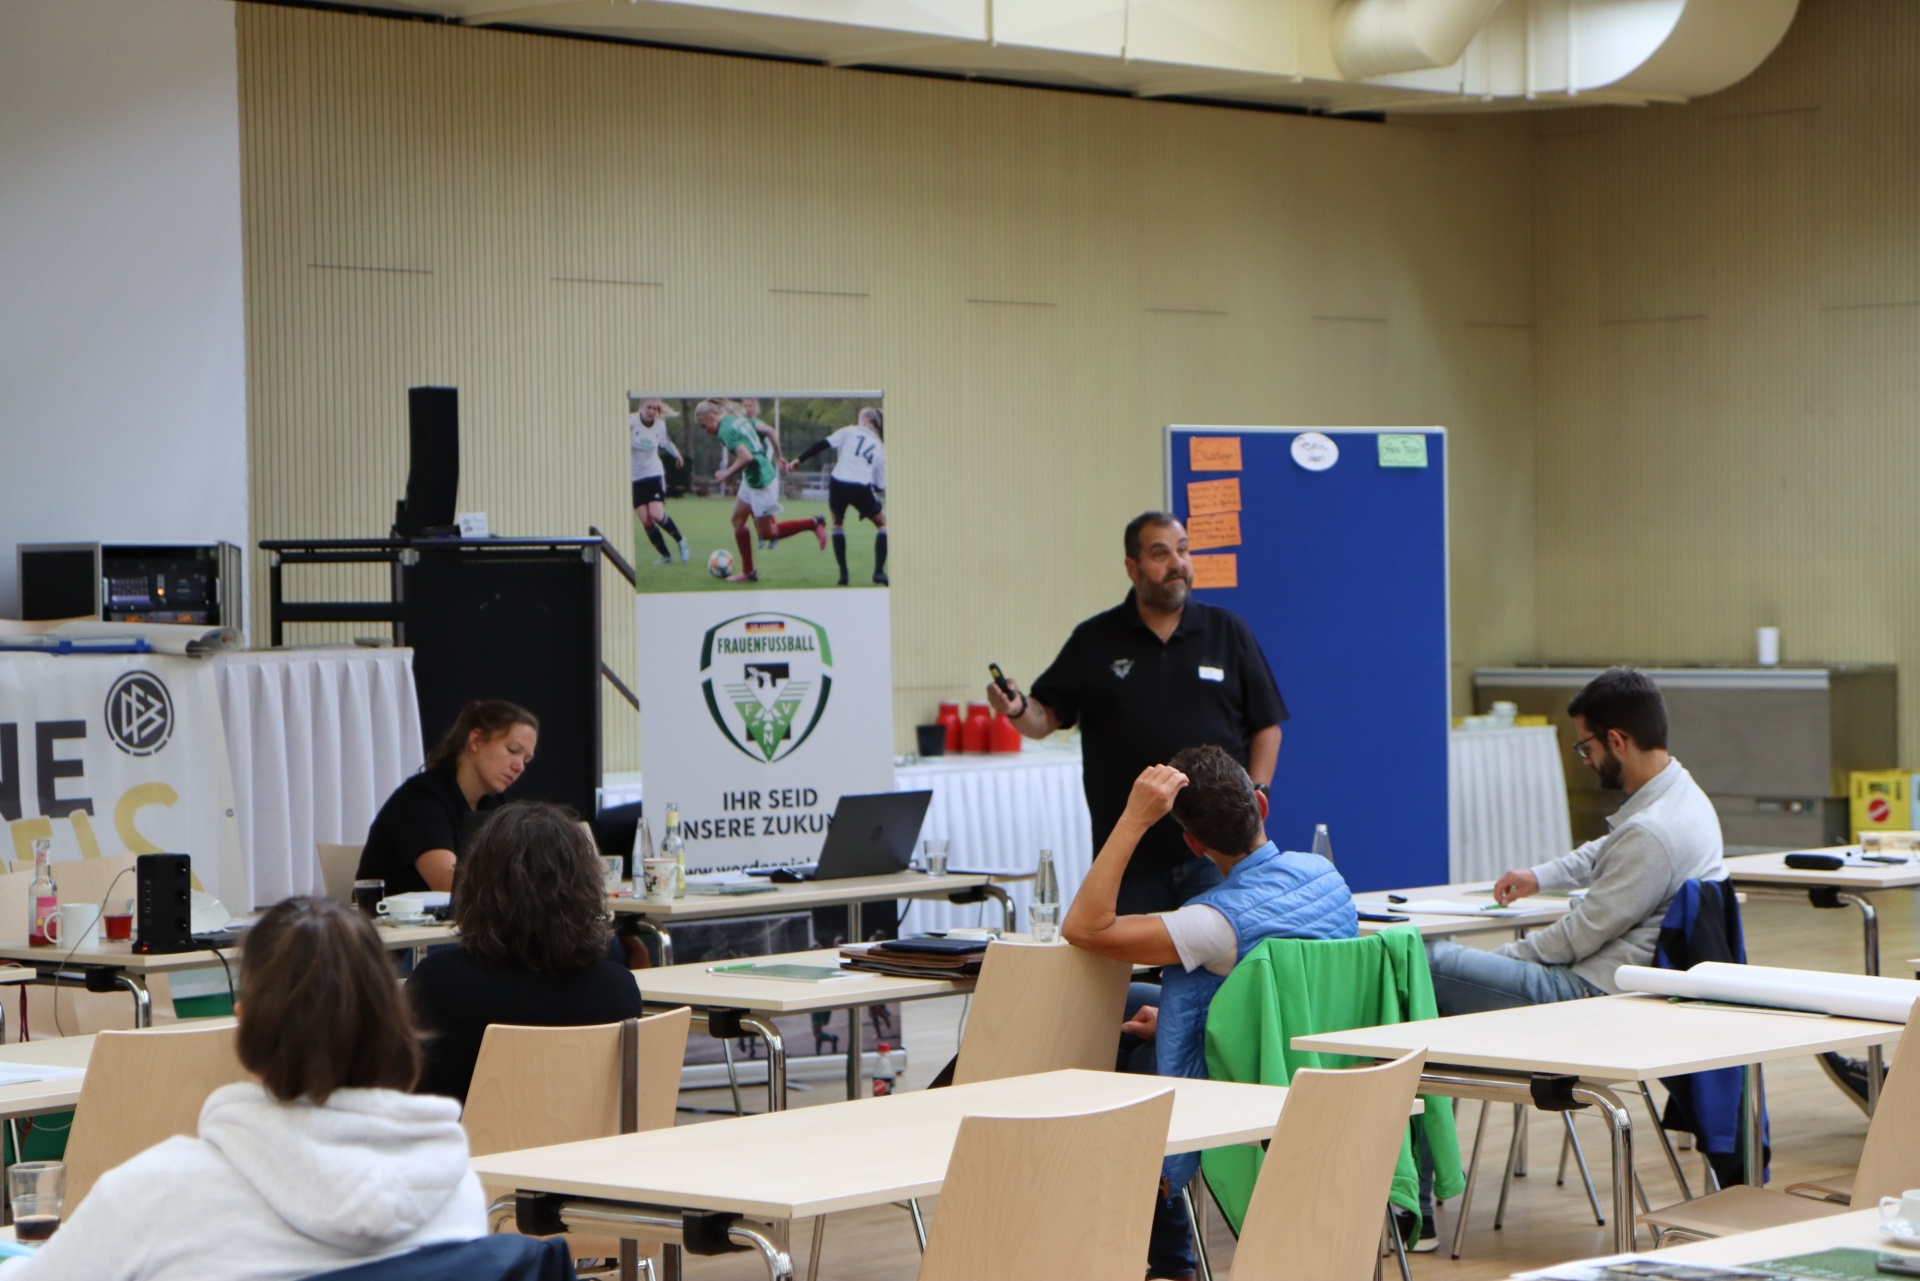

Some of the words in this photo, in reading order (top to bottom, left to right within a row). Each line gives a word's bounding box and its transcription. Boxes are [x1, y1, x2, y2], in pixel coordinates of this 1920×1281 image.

[855, 435, 876, 465] 14
[717, 635, 815, 654] FRAUENFUSSBALL
[723, 791, 761, 811] IHR
[769, 788, 818, 809] SEID
